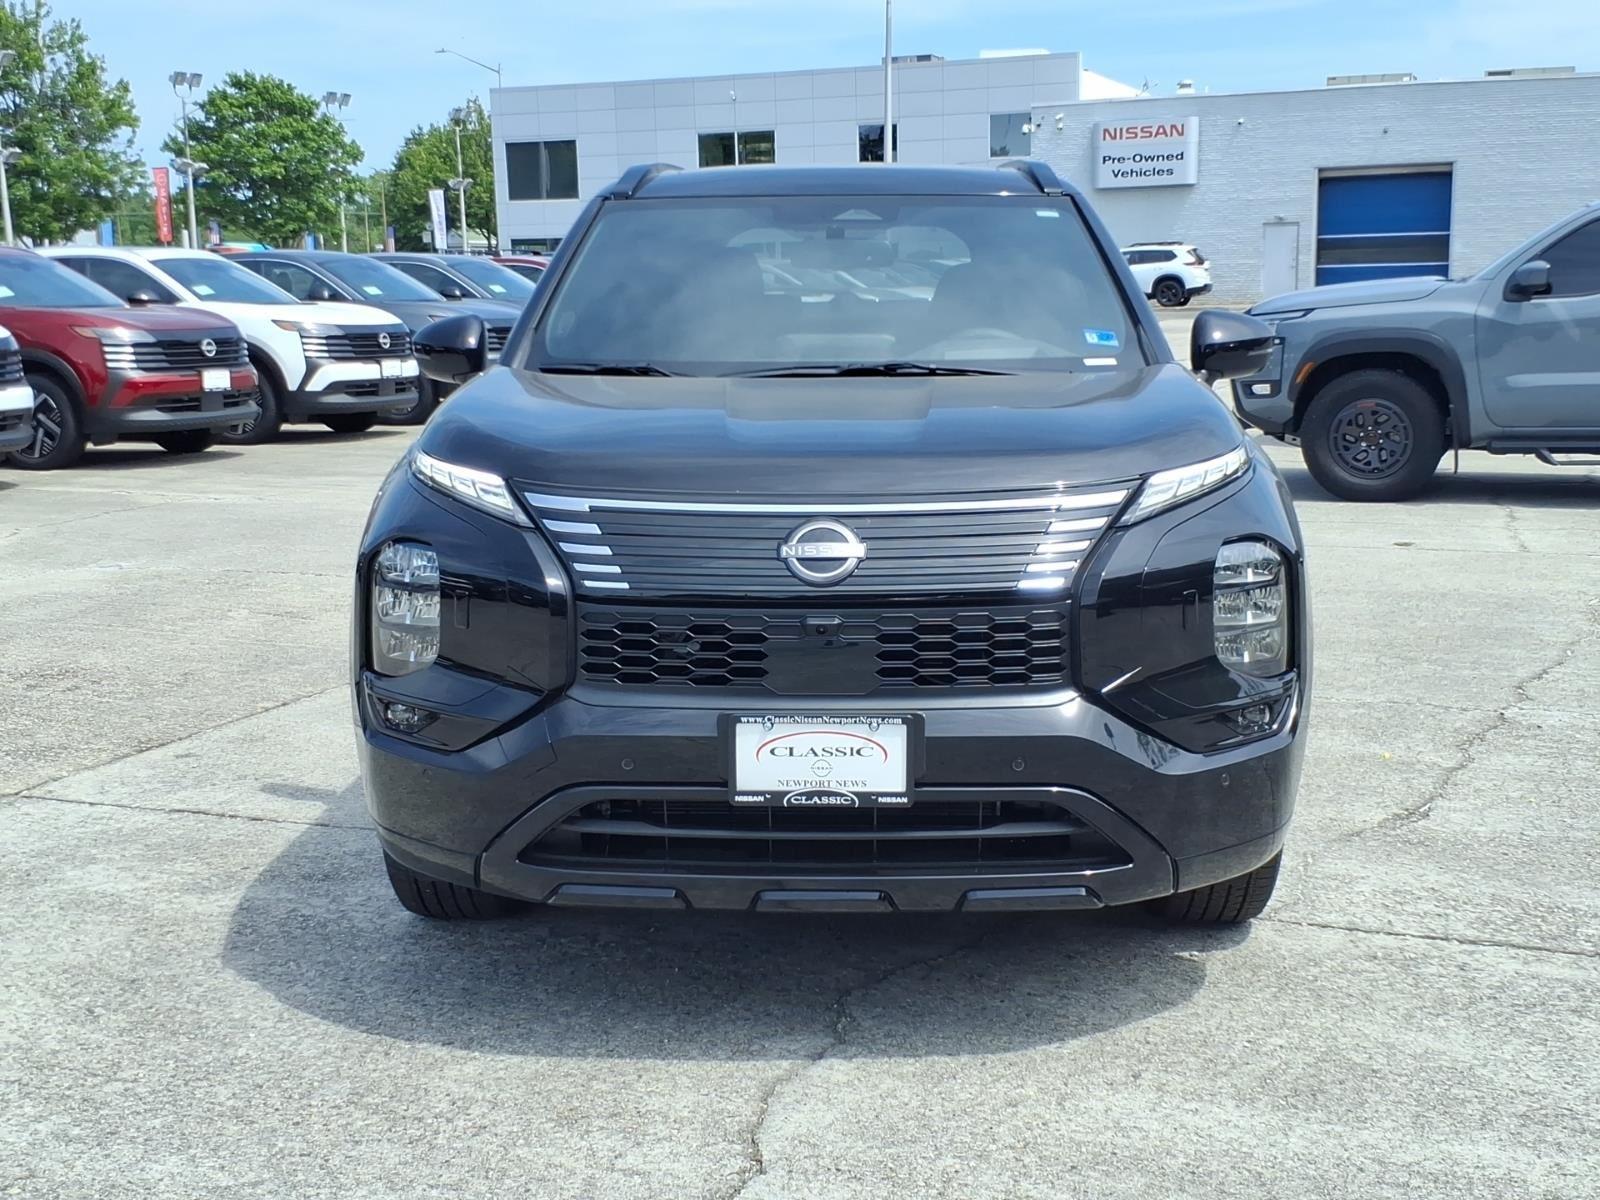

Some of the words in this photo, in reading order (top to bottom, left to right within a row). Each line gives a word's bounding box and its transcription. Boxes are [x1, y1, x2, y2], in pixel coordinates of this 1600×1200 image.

[1103, 124, 1184, 141] NISSAN
[1102, 152, 1184, 164] Pre-Owned
[1112, 168, 1174, 178] Vehicles
[782, 546, 862, 556] NISS
[741, 715, 902, 725] www.ClassicNissanNewportNews.com
[769, 746, 874, 757] CLASSIC
[778, 779, 832, 788] NEWPORT
[836, 779, 867, 788] NEWS
[790, 796, 851, 804] CLASSIC
